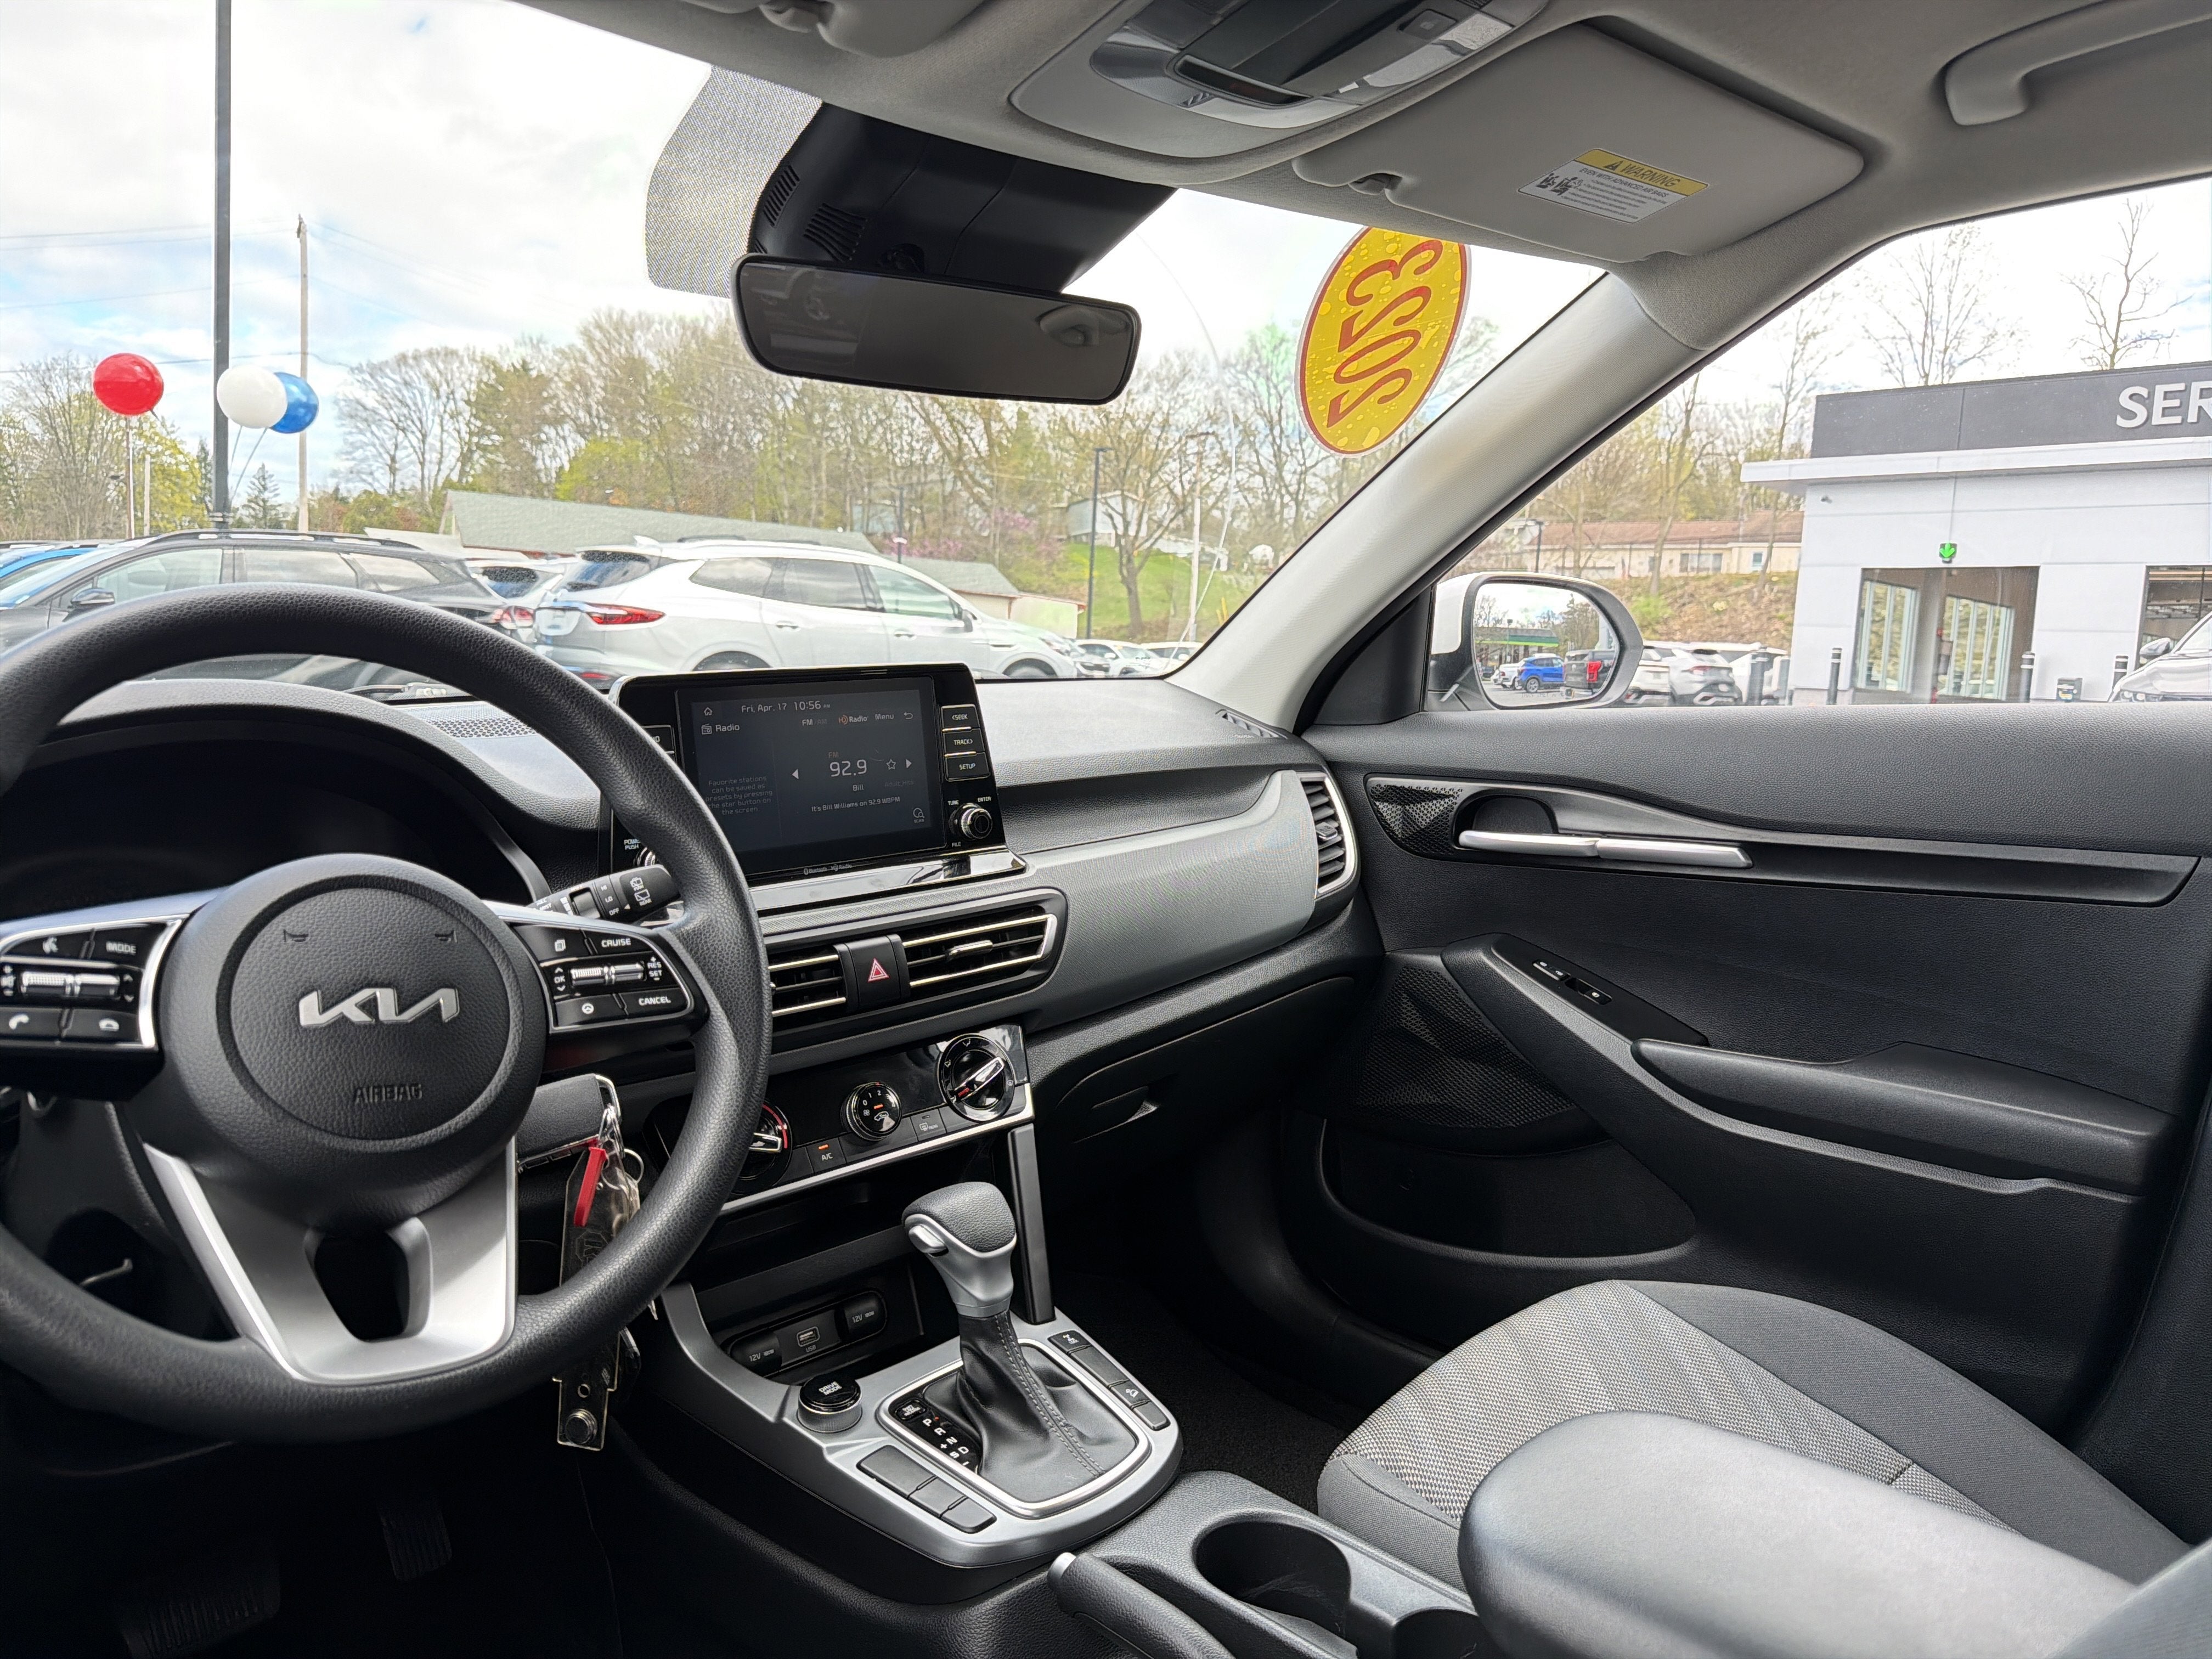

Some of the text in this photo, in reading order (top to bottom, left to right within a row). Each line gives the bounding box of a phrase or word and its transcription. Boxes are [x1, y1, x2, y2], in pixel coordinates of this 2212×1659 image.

[1622, 164, 1680, 187] WARNING
[1579, 167, 1595, 176] EVEN
[1612, 178, 1643, 191] ADVANCED
[1651, 189, 1669, 198] BAGS
[2116, 381, 2212, 427] SER
[758, 704, 775, 712] Apr.
[794, 700, 821, 710] 10:56
[715, 724, 740, 732] Radio
[830, 759, 867, 777] 92.9
[706, 794, 732, 802] presets
[609, 907, 619, 916] OFF
[106, 941, 137, 955] MODE
[601, 938, 631, 948] CRUISE
[554, 975, 566, 984] OK
[638, 996, 672, 1006] CANCEL
[299, 987, 460, 1027] KIA
[354, 1083, 422, 1104] AIRBAG
[821, 1153, 833, 1161] A/C
[852, 1314, 863, 1323] 12V
[749, 1352, 761, 1362] 12V
[819, 1381, 838, 1393] DRIVE
[823, 1385, 842, 1396] MODE
[923, 1418, 932, 1427] P
[934, 1427, 946, 1436] R
[946, 1436, 958, 1445] N
[957, 1446, 969, 1454] D
